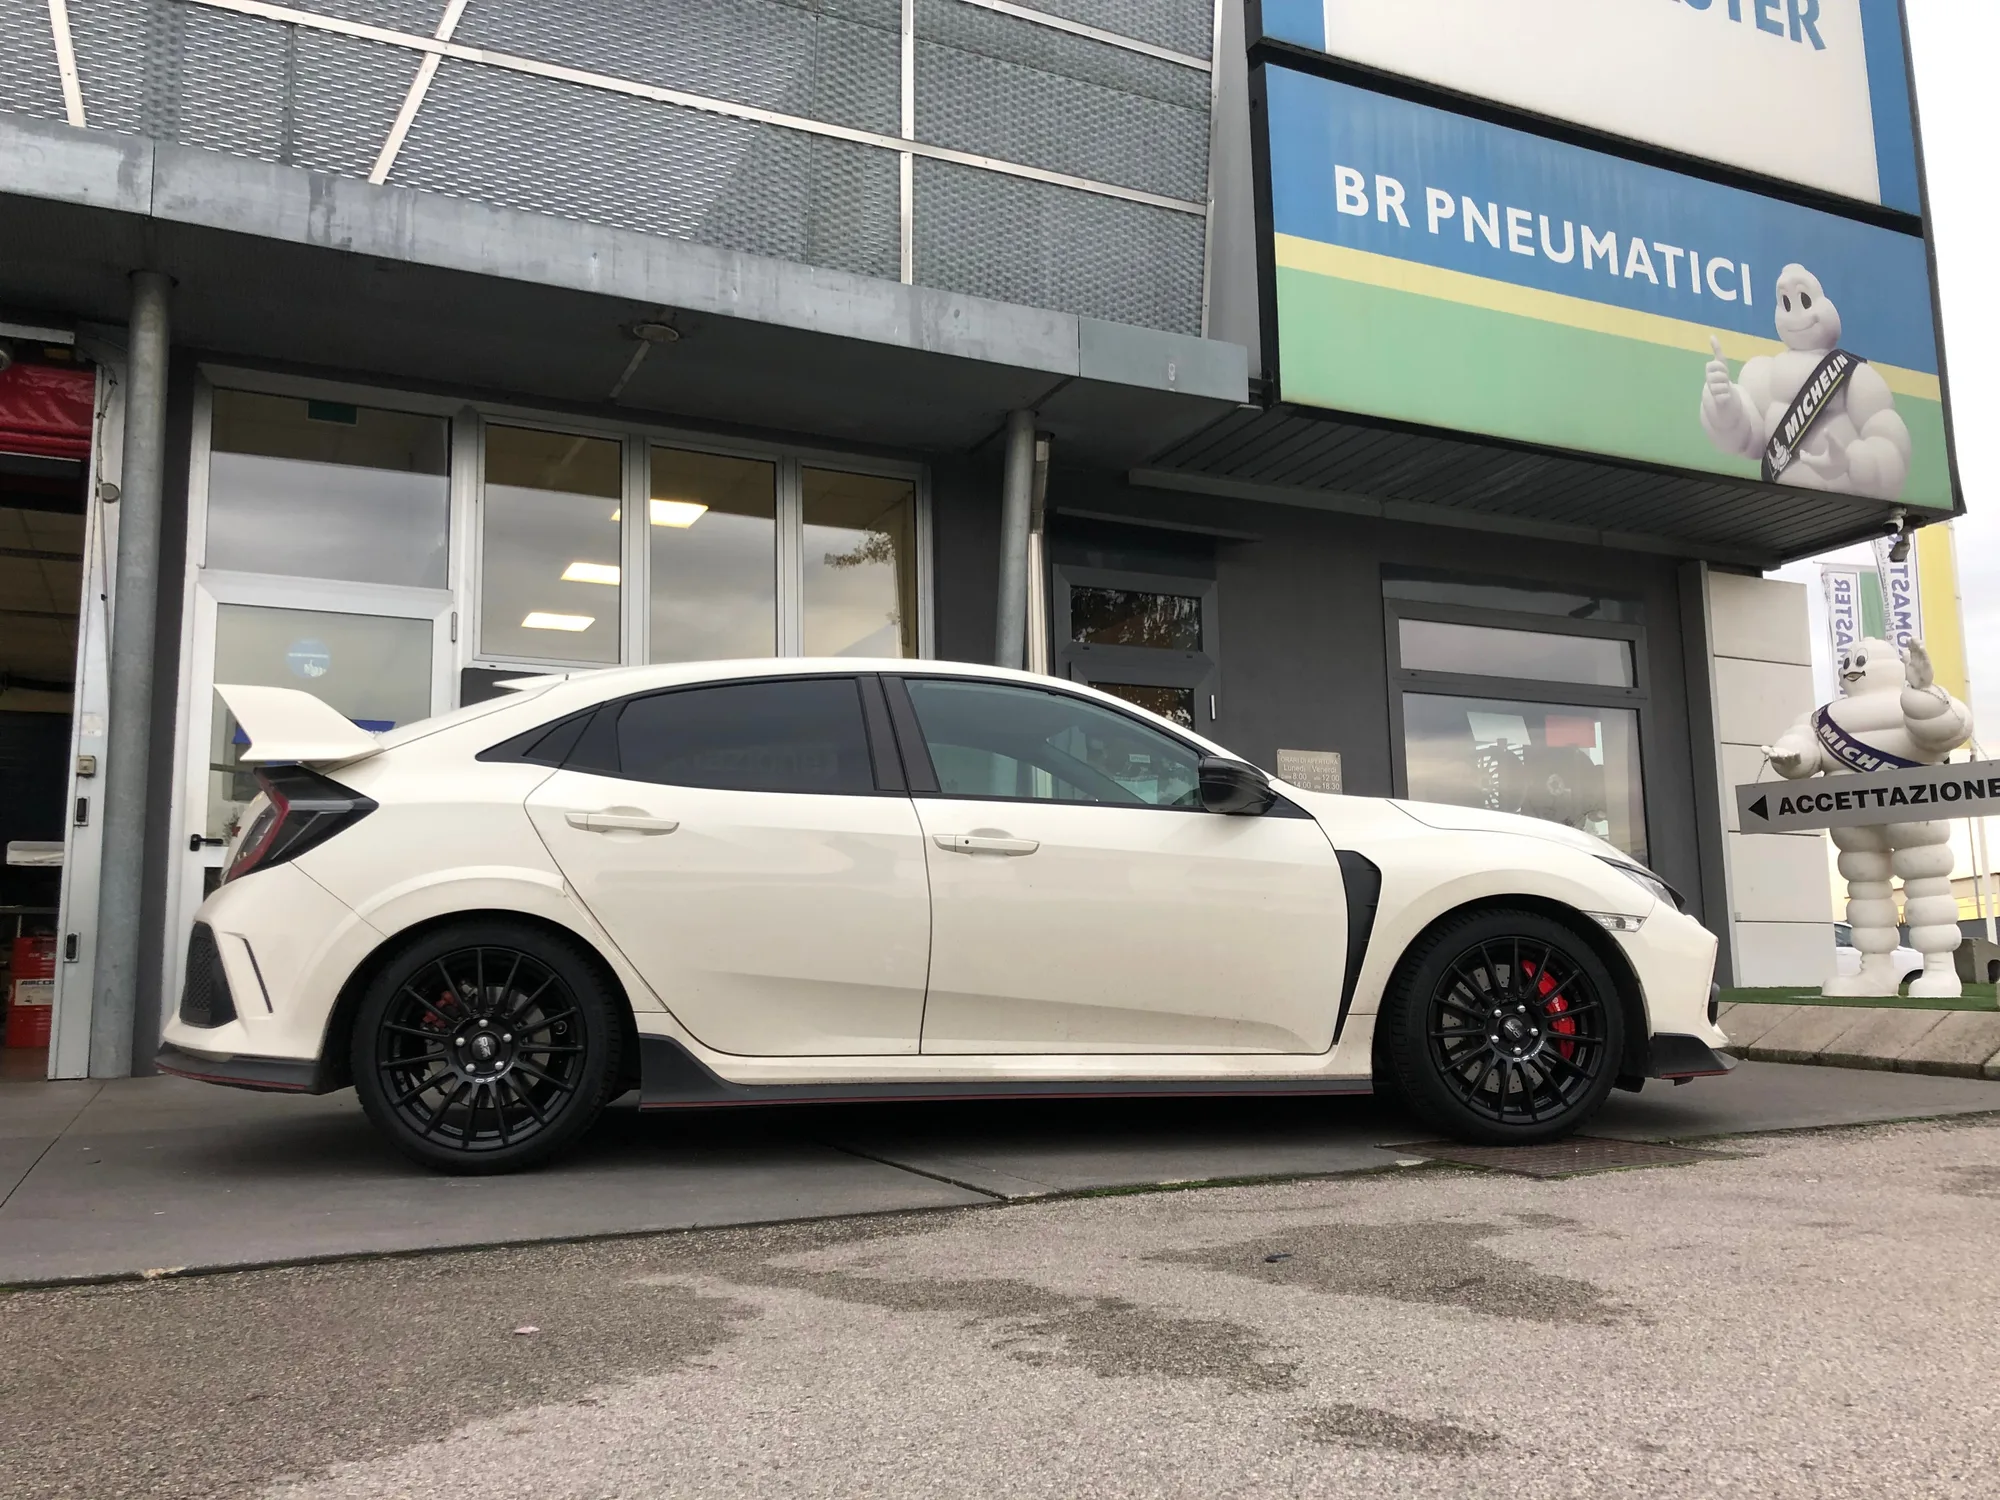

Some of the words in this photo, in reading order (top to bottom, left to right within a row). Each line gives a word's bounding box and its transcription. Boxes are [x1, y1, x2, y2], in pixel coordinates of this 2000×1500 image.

[1334, 164, 1410, 228] BR
[1426, 186, 1752, 306] PNEUMATICI
[1785, 354, 1848, 443] MICHELIN
[1779, 776, 2000, 816] ACCETTAZIONE
